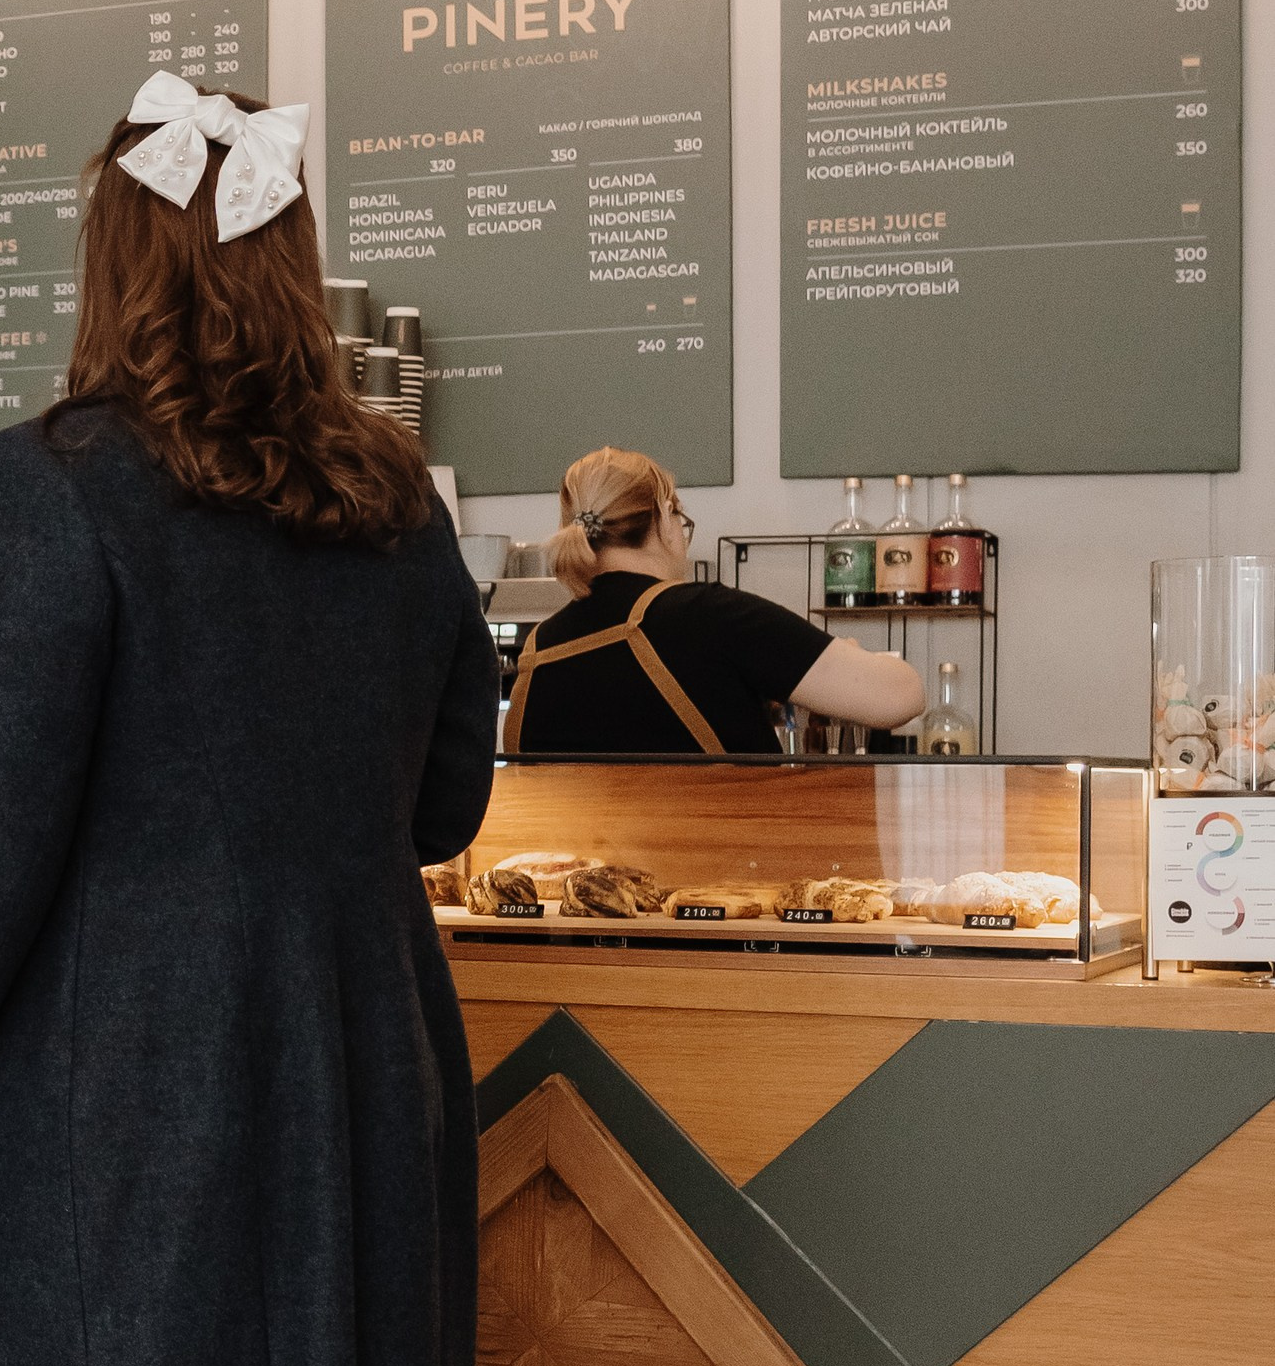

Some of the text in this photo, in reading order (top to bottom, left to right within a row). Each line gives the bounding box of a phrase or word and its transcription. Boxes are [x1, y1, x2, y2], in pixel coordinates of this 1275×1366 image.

[149, 11, 171, 25] 190
[808, 5, 865, 23] МАТЧА
[149, 30, 171, 43] 190
[214, 22, 240, 37] 240
[807, 19, 911, 43] АВТОРСКИЙ
[915, 16, 951, 34] ЧАЙ
[148, 48, 172, 62] 220
[180, 44, 206, 59] 280
[214, 41, 239, 55] 320
[180, 63, 206, 77] 280
[214, 60, 239, 74] 320
[443, 48, 599, 75] COFFEE & CACAO BAR
[807, 72, 948, 98] MILKSHAKES
[807, 91, 946, 111] МОЛОЧНЫЕ КОКТЕЙЛИ
[539, 121, 577, 134] КАКАО
[586, 115, 639, 131] ГОРЯЧИЙ
[642, 110, 702, 126] ШОКОЛАД
[806, 103, 1207, 144] МОЛОЧНЫЙ КОКТЕЙЛЬ 260
[349, 129, 485, 155] BEAN-TO-BAR
[807, 140, 914, 158] В АССОРТИМЕНТЕ
[429, 137, 703, 173] 320 350 380
[806, 141, 1207, 180] КОФЕЙНО-БАНАНОВЫЙ 350
[588, 172, 656, 190] UGANDA
[0, 188, 77, 206] 200/240/290
[467, 184, 508, 200] PERU
[588, 188, 685, 208] PHILIPPINES
[349, 194, 401, 210] BRAZIL
[467, 199, 557, 219] VENEZUELA
[55, 206, 77, 219] 190
[349, 208, 433, 227] HONDURAS
[588, 208, 676, 227] INDONESIA
[467, 218, 542, 236] ECUADOR
[807, 212, 947, 235] FRESH JUICE
[349, 225, 446, 245] DOMINICANA
[588, 227, 668, 245] THAILAND
[807, 231, 939, 249] СВЕЖЕВЫЖАТЫЙ СОК
[349, 244, 436, 263] NICARAGUA
[588, 246, 667, 263] TANZANIA
[588, 263, 700, 282] MADAGASCAR
[806, 246, 1207, 281] АПЕЛЬСИНОВЫЙ 300
[9, 284, 40, 298] PINE
[53, 283, 76, 296] 320
[806, 268, 1206, 301] ГРЕЙПФРУТОВЫЙ 320
[53, 301, 76, 314] 320
[637, 337, 704, 353] 240 270
[422, 363, 502, 379] ОР ДЛЯ ДЕТЕЙ
